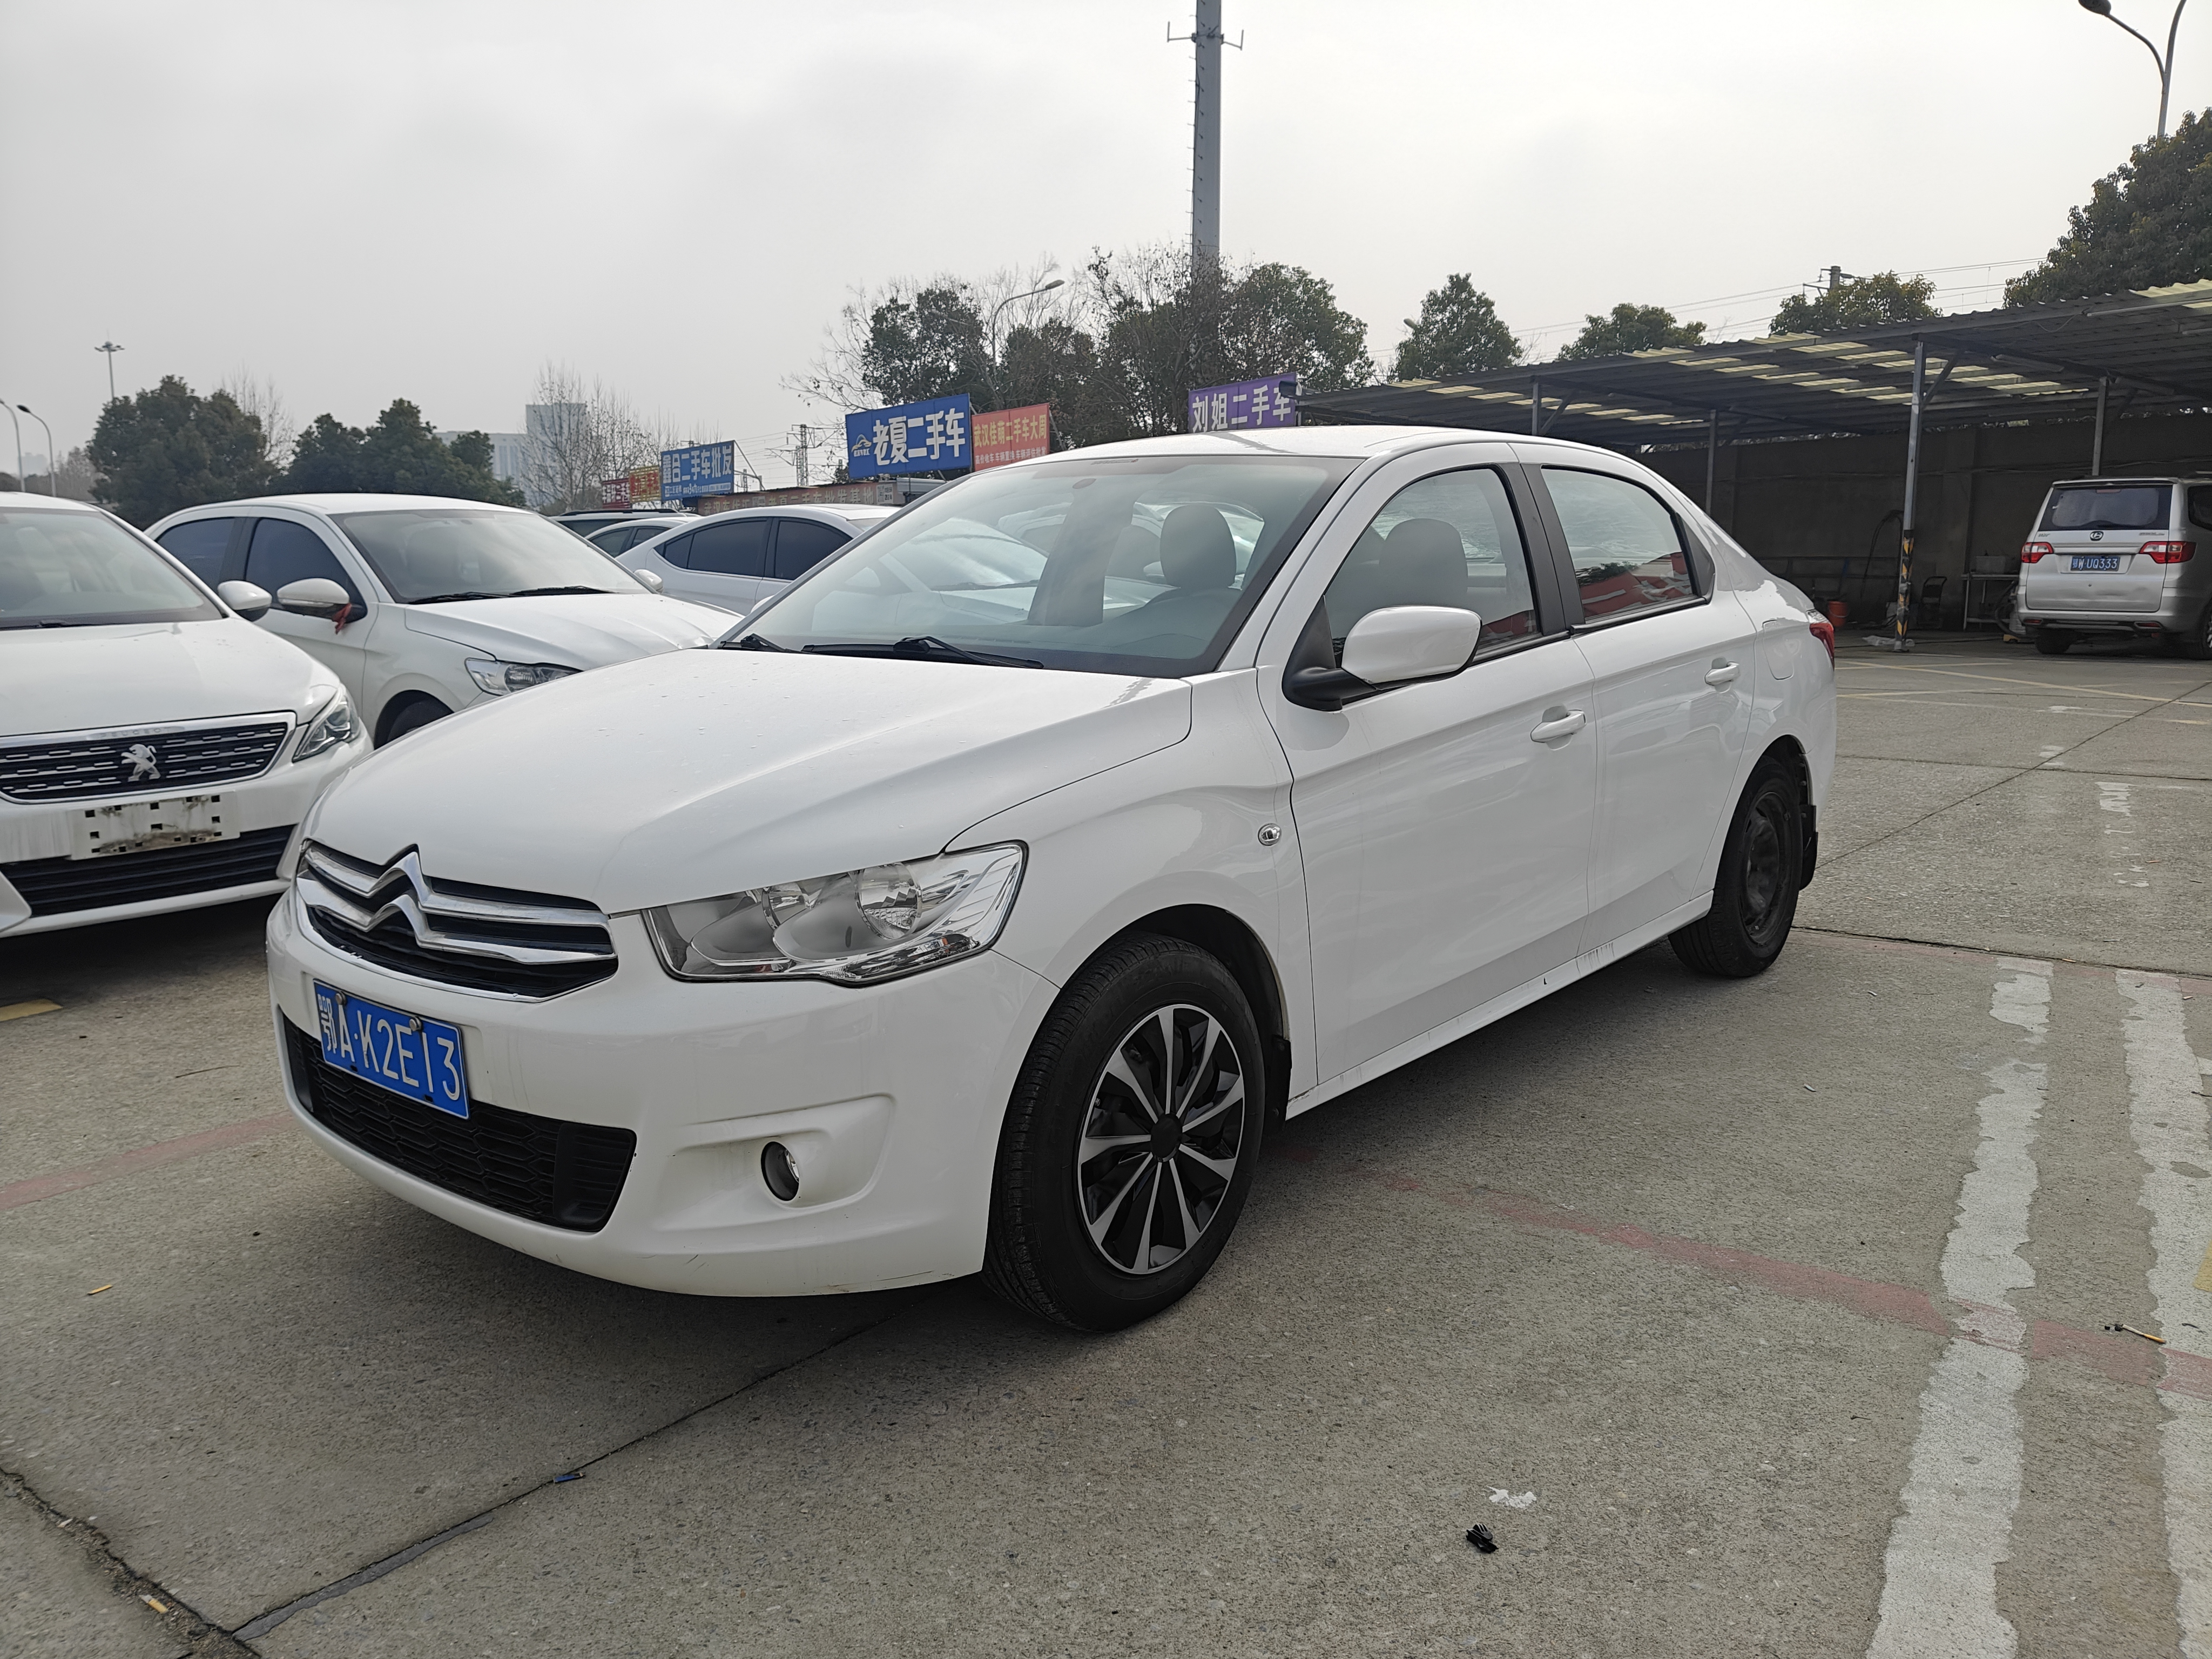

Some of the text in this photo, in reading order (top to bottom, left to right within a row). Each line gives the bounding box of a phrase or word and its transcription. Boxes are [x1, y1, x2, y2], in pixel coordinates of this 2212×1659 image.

[1192, 384, 1291, 433] 刘姐二手车
[873, 408, 966, 466] 老夏二手车
[663, 446, 732, 483] 鑫合二手车批发
